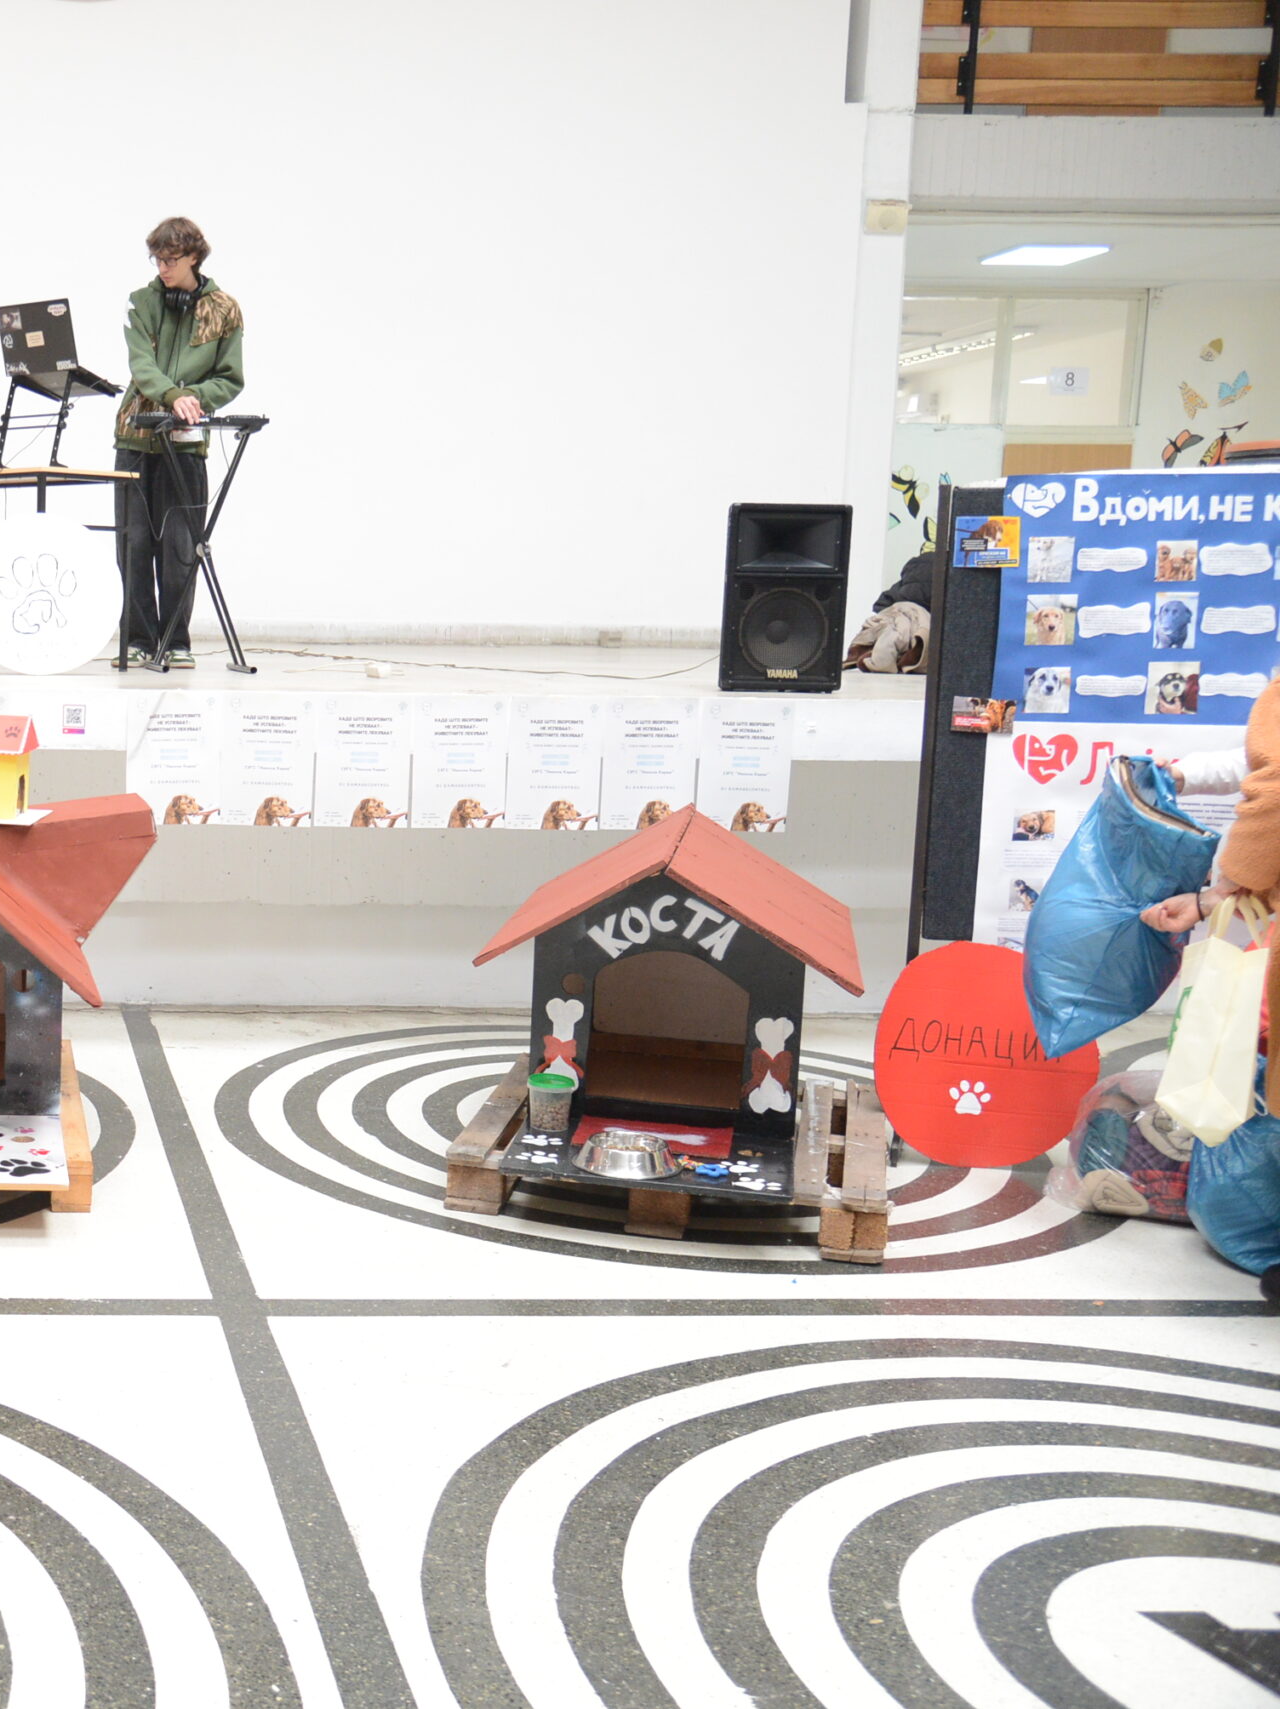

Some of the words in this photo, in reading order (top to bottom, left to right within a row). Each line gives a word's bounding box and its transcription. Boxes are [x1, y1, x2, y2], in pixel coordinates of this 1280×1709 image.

[1065, 372, 1075, 387] 8
[766, 669, 798, 679] YAMAHA
[586, 894, 740, 961] КОСТА
[888, 1017, 1061, 1067] ДОНАЦИ
